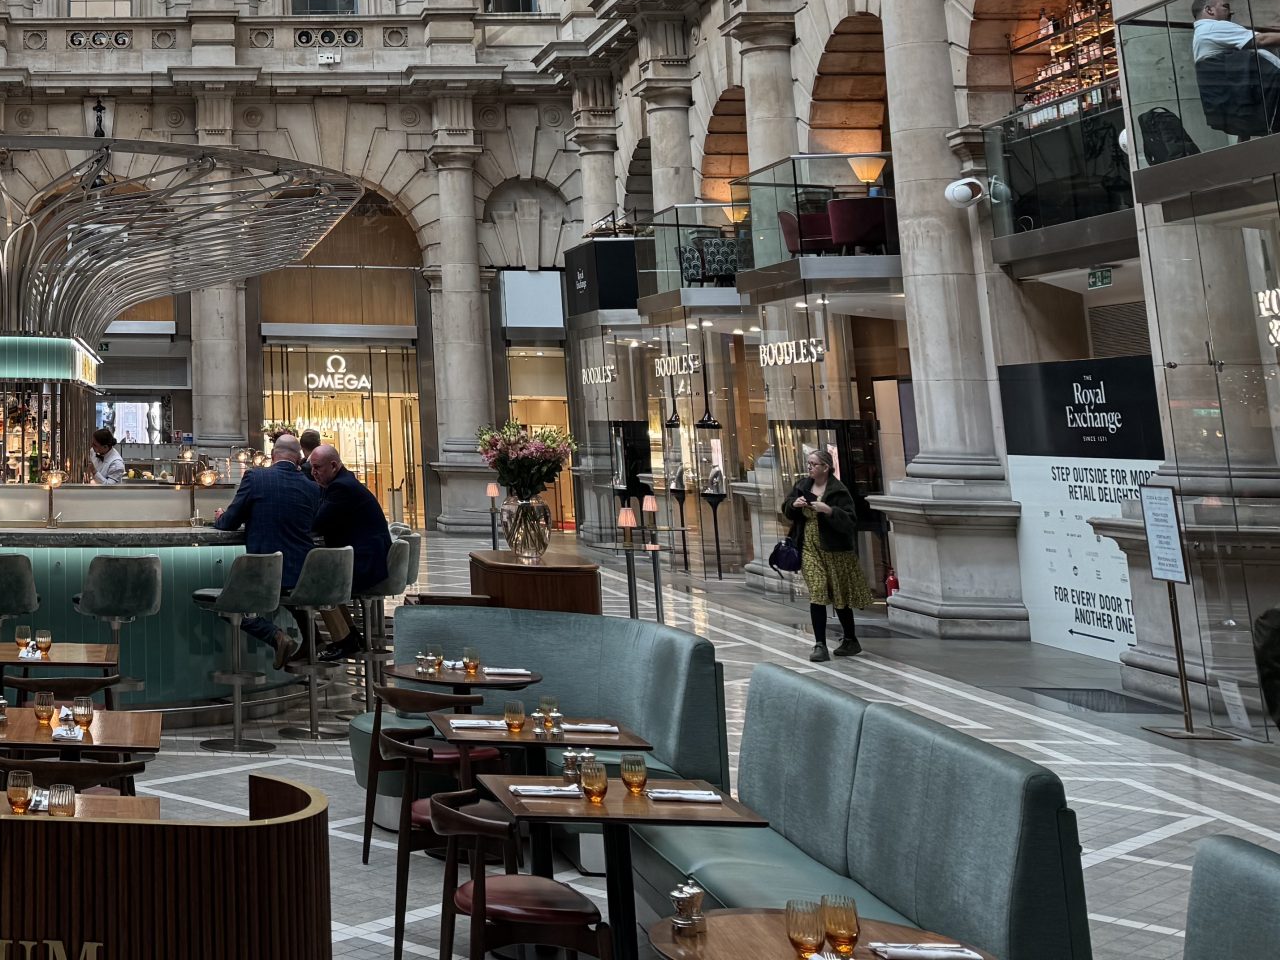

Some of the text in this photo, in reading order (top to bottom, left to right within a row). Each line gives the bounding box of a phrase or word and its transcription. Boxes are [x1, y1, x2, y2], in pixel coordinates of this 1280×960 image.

[759, 338, 817, 367] BOODLES
[582, 365, 612, 384] BOODLES
[654, 354, 694, 377] BOODLES
[304, 373, 372, 389] OMEGA
[1072, 380, 1106, 410] Royal
[1065, 405, 1122, 434] Exchange
[1051, 465, 1071, 482] STEP
[1072, 467, 1109, 485] OUTSIDE
[1110, 468, 1128, 486] FOR
[1068, 484, 1097, 502] RETAIL
[1054, 585, 1070, 604] FOR
[1070, 588, 1096, 609] EVERY
[1099, 593, 1123, 614] DOOR
[1074, 607, 1114, 631] ANOTHER
[1115, 615, 1135, 635] ONE
